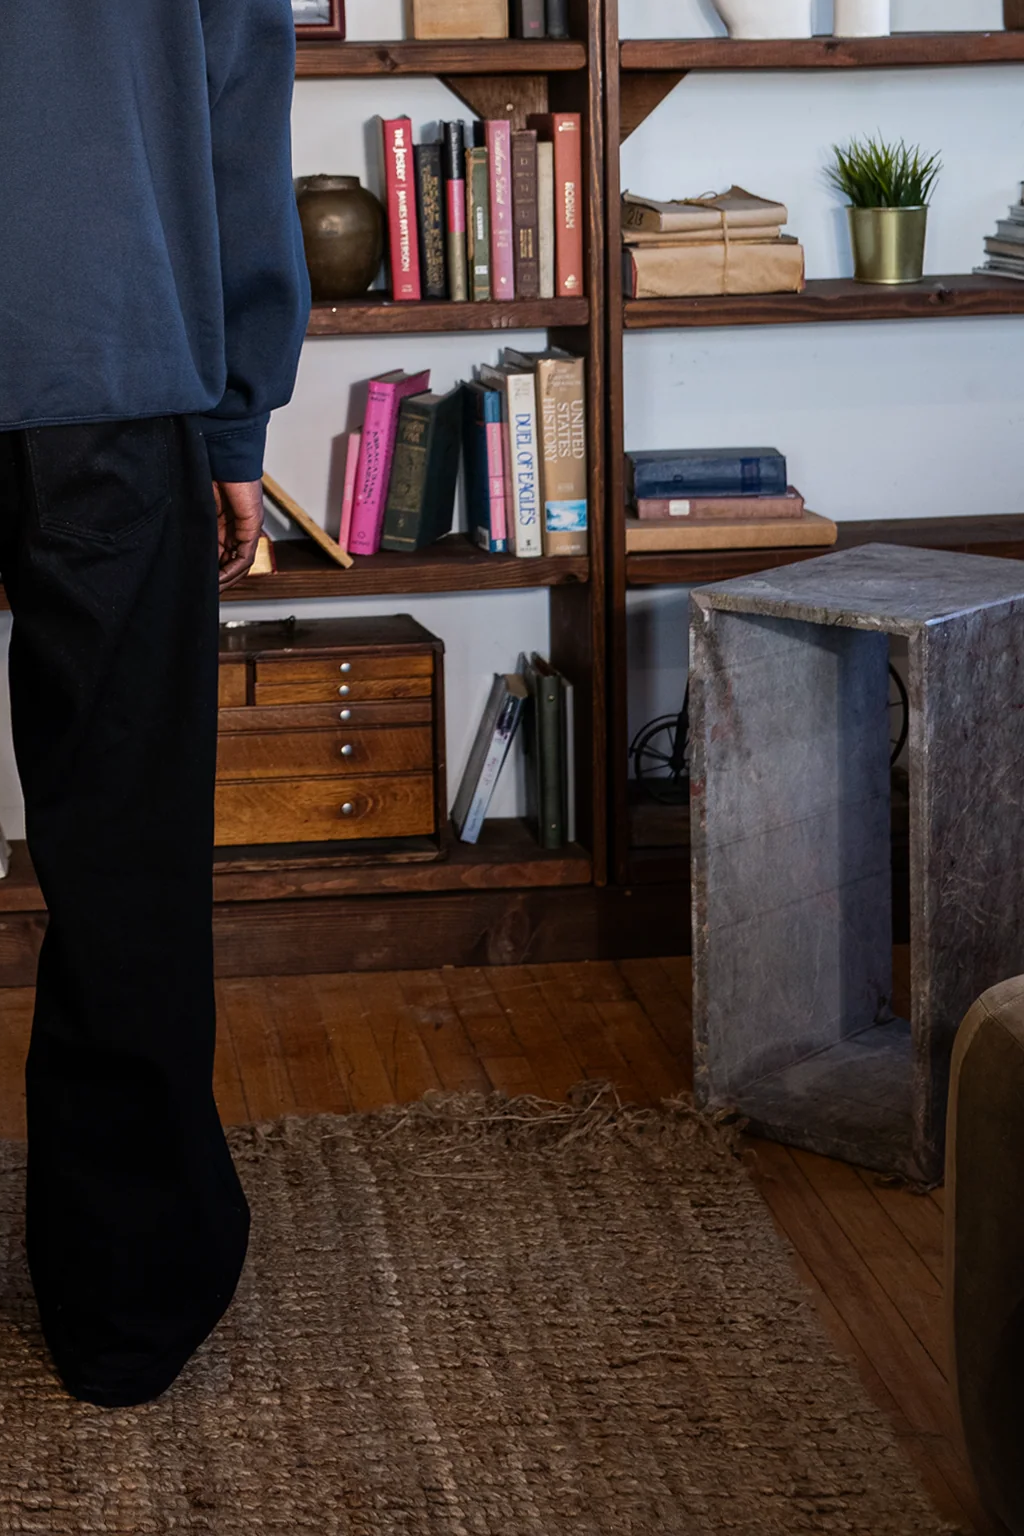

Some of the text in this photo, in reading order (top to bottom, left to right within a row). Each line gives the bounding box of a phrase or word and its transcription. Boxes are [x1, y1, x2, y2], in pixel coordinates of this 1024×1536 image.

[394, 128, 404, 148] THE
[494, 129, 506, 175] Southern
[393, 146, 407, 182] Jester
[397, 190, 407, 219] JAMES
[564, 181, 575, 229] RODHAM
[399, 219, 410, 272] PATTERSON
[543, 397, 557, 463] HISTORY
[557, 401, 571, 458] STATES
[571, 399, 585, 460] UNITED
[515, 413, 536, 527] DUEL OF EAGLES
